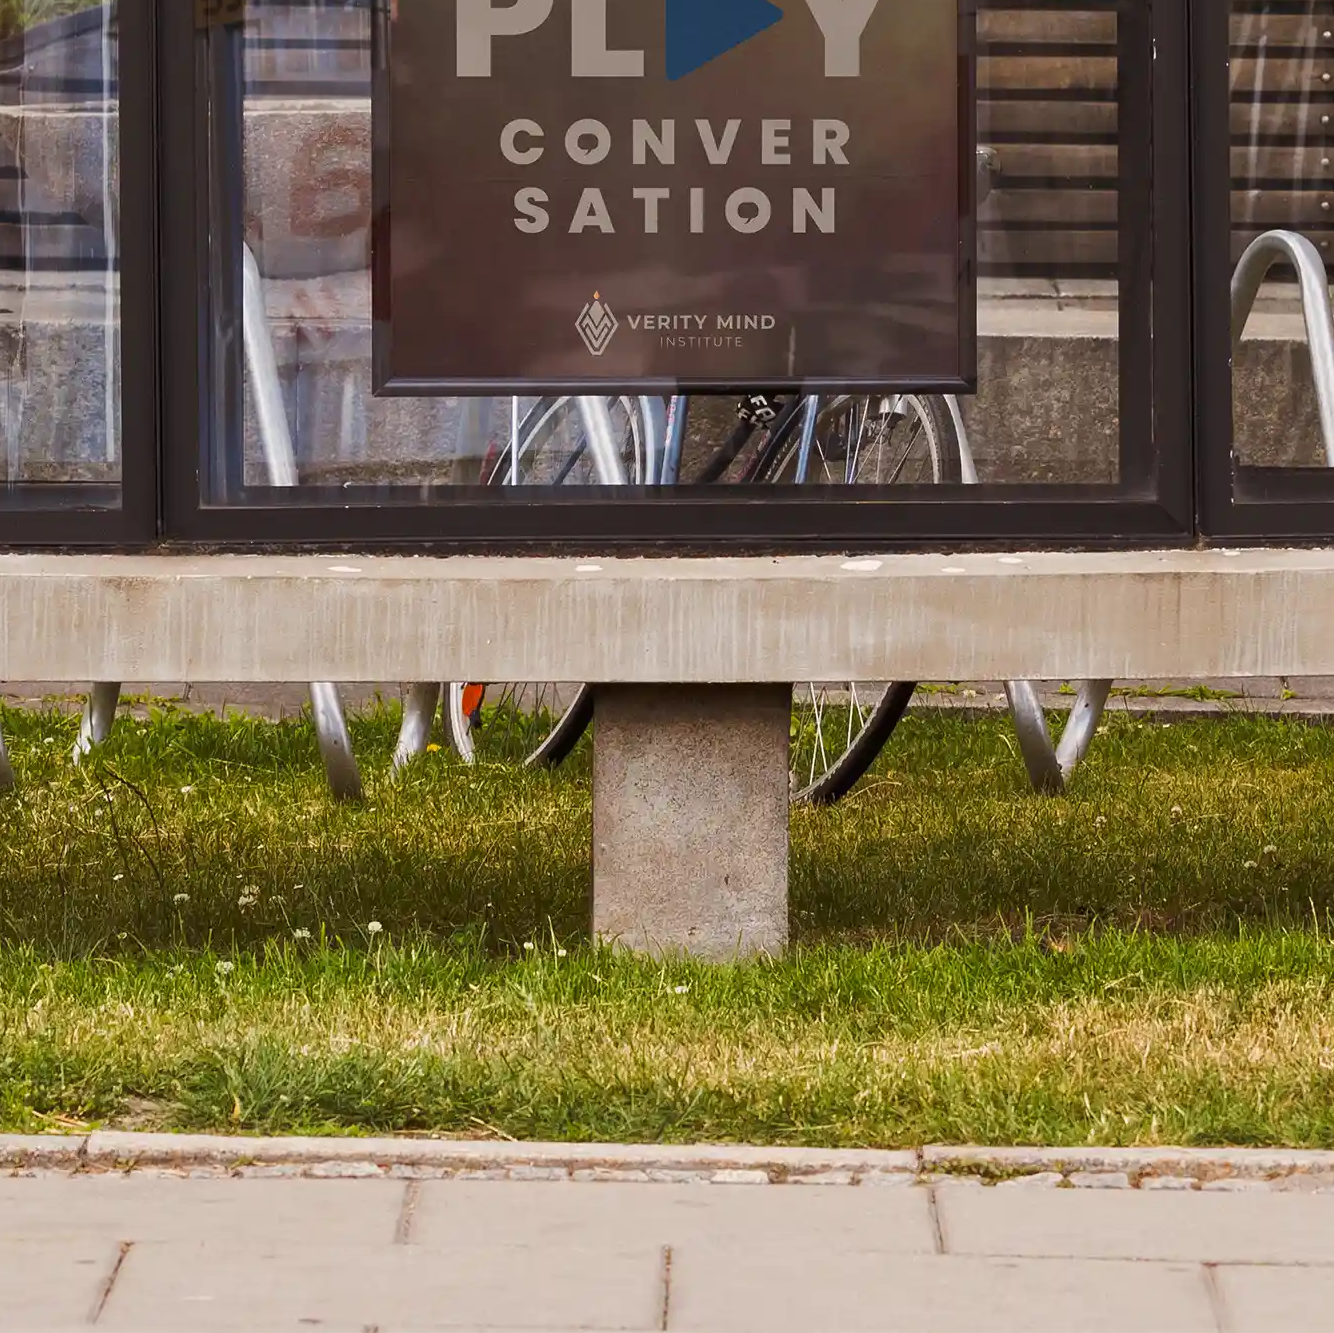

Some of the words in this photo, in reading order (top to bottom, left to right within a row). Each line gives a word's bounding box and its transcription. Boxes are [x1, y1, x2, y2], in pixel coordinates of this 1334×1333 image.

[499, 118, 851, 166] CONVER
[513, 186, 836, 234] SATION
[626, 314, 707, 330] VERITY
[716, 314, 776, 330] MIND
[659, 336, 743, 348] INSTITUTE
